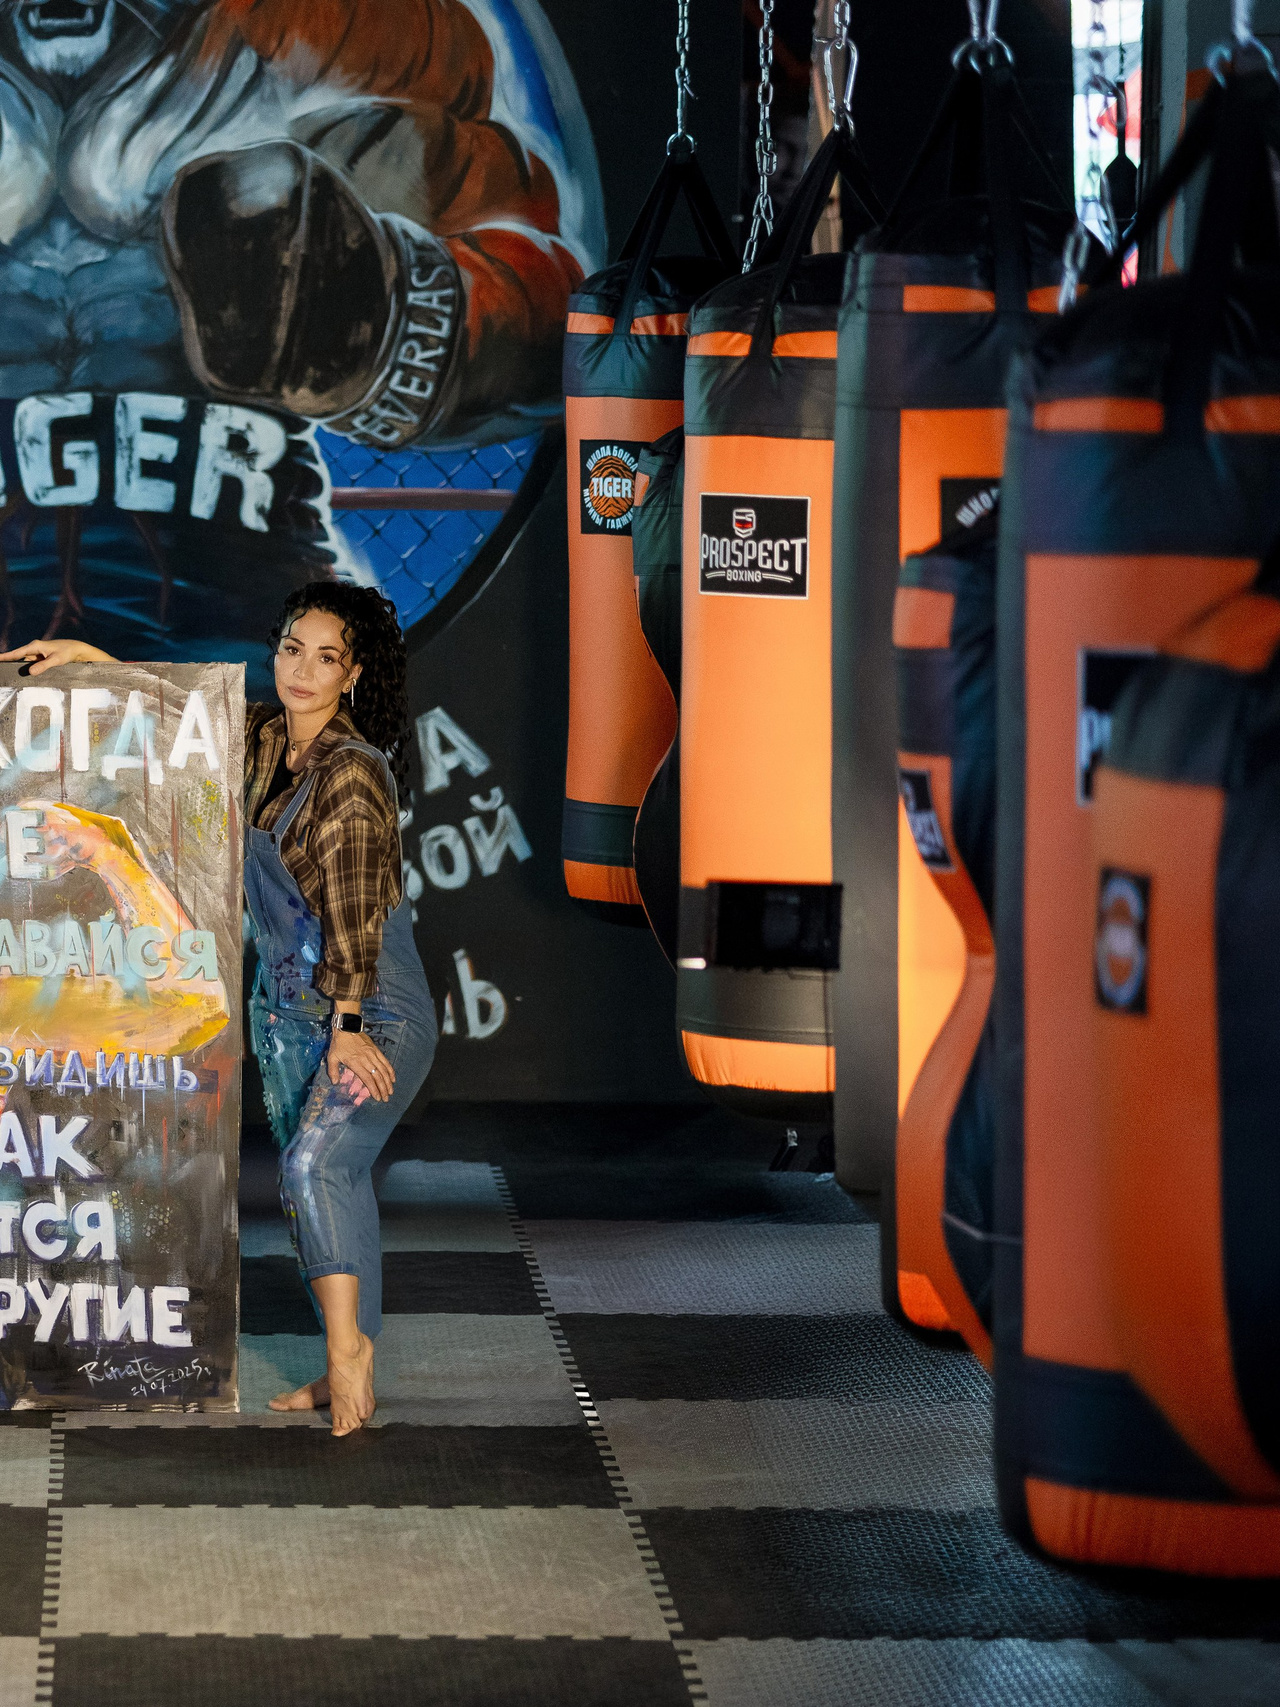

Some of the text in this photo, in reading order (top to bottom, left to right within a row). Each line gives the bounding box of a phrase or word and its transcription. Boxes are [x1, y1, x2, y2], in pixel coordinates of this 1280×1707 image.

[351, 234, 457, 444] EVERLAST
[586, 445, 639, 473] ШКОЛА БОКСА
[591, 477, 633, 498] TIGER
[582, 487, 604, 526] МАРИНЫ
[700, 533, 808, 576] PROSPECT
[726, 569, 762, 583] BOXING
